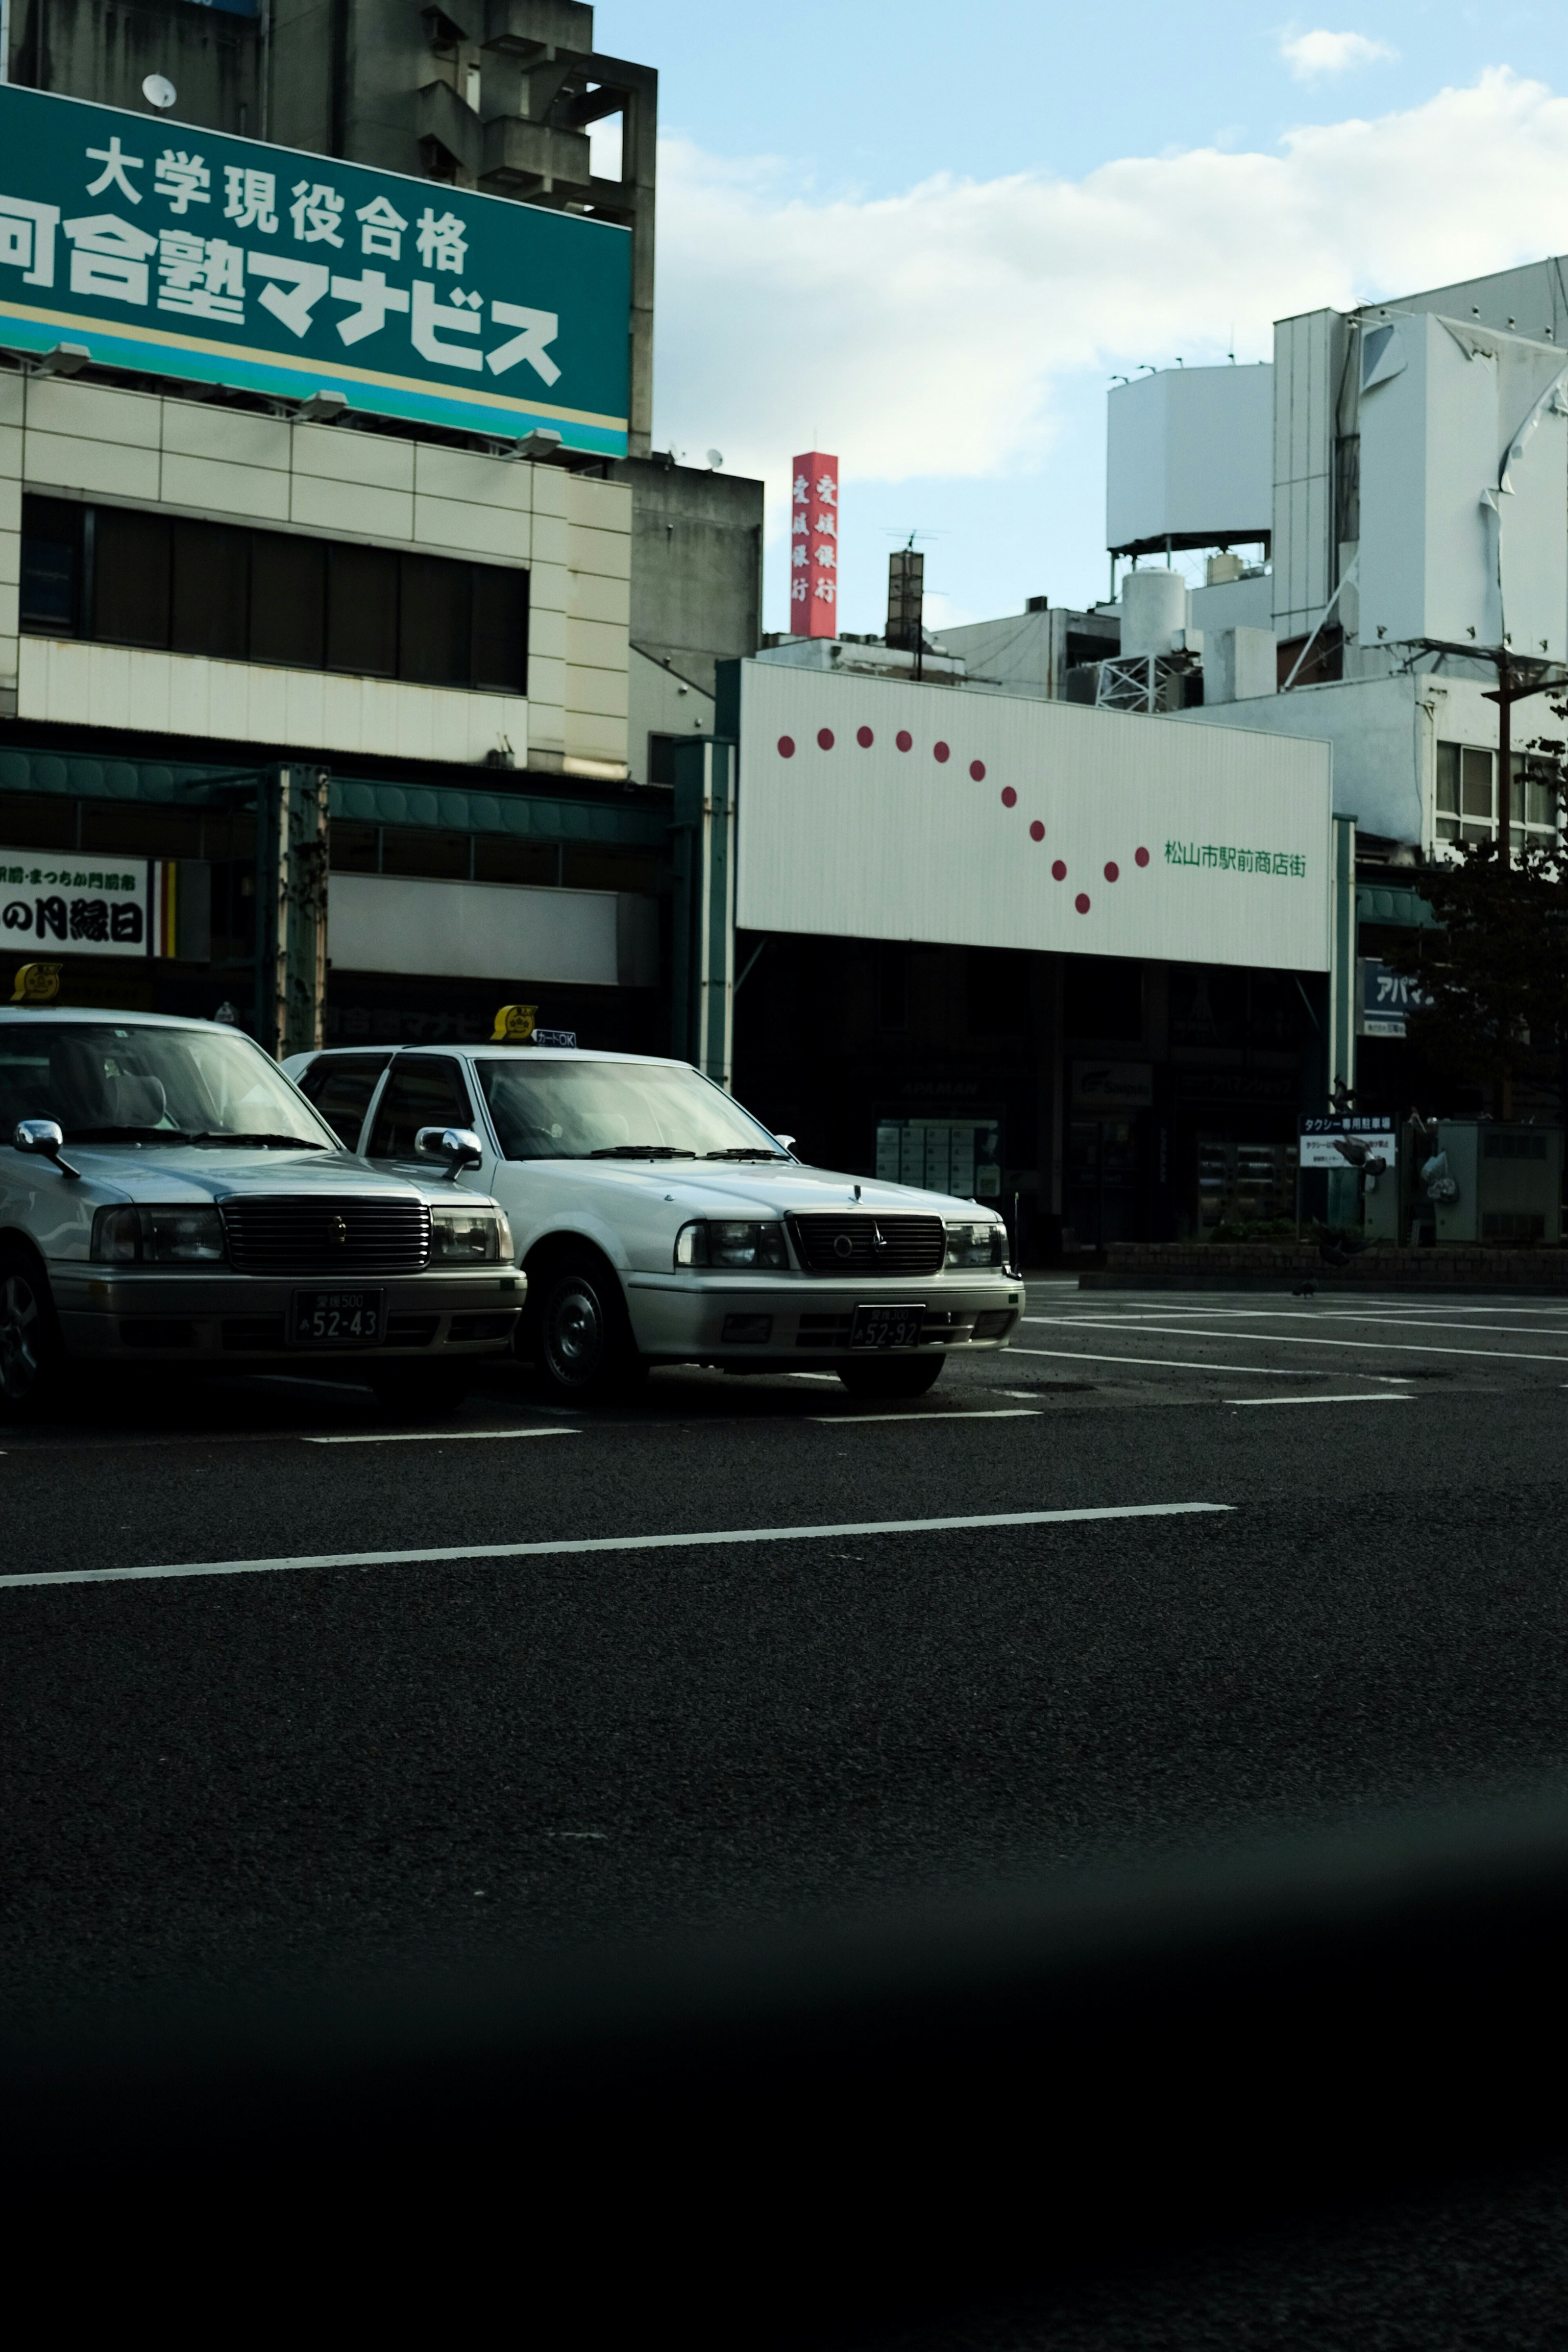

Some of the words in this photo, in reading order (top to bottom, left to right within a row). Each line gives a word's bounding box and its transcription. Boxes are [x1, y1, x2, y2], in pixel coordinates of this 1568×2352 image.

[86, 136, 470, 276] 大学現役合格
[1164, 840, 1306, 878] 松山市駅前商店街
[538, 1031, 574, 1047] カードOK
[1305, 1116, 1391, 1132] タクシー専用駐車場
[312, 1310, 377, 1337] 52-43
[865, 1322, 918, 1345] 52-92
